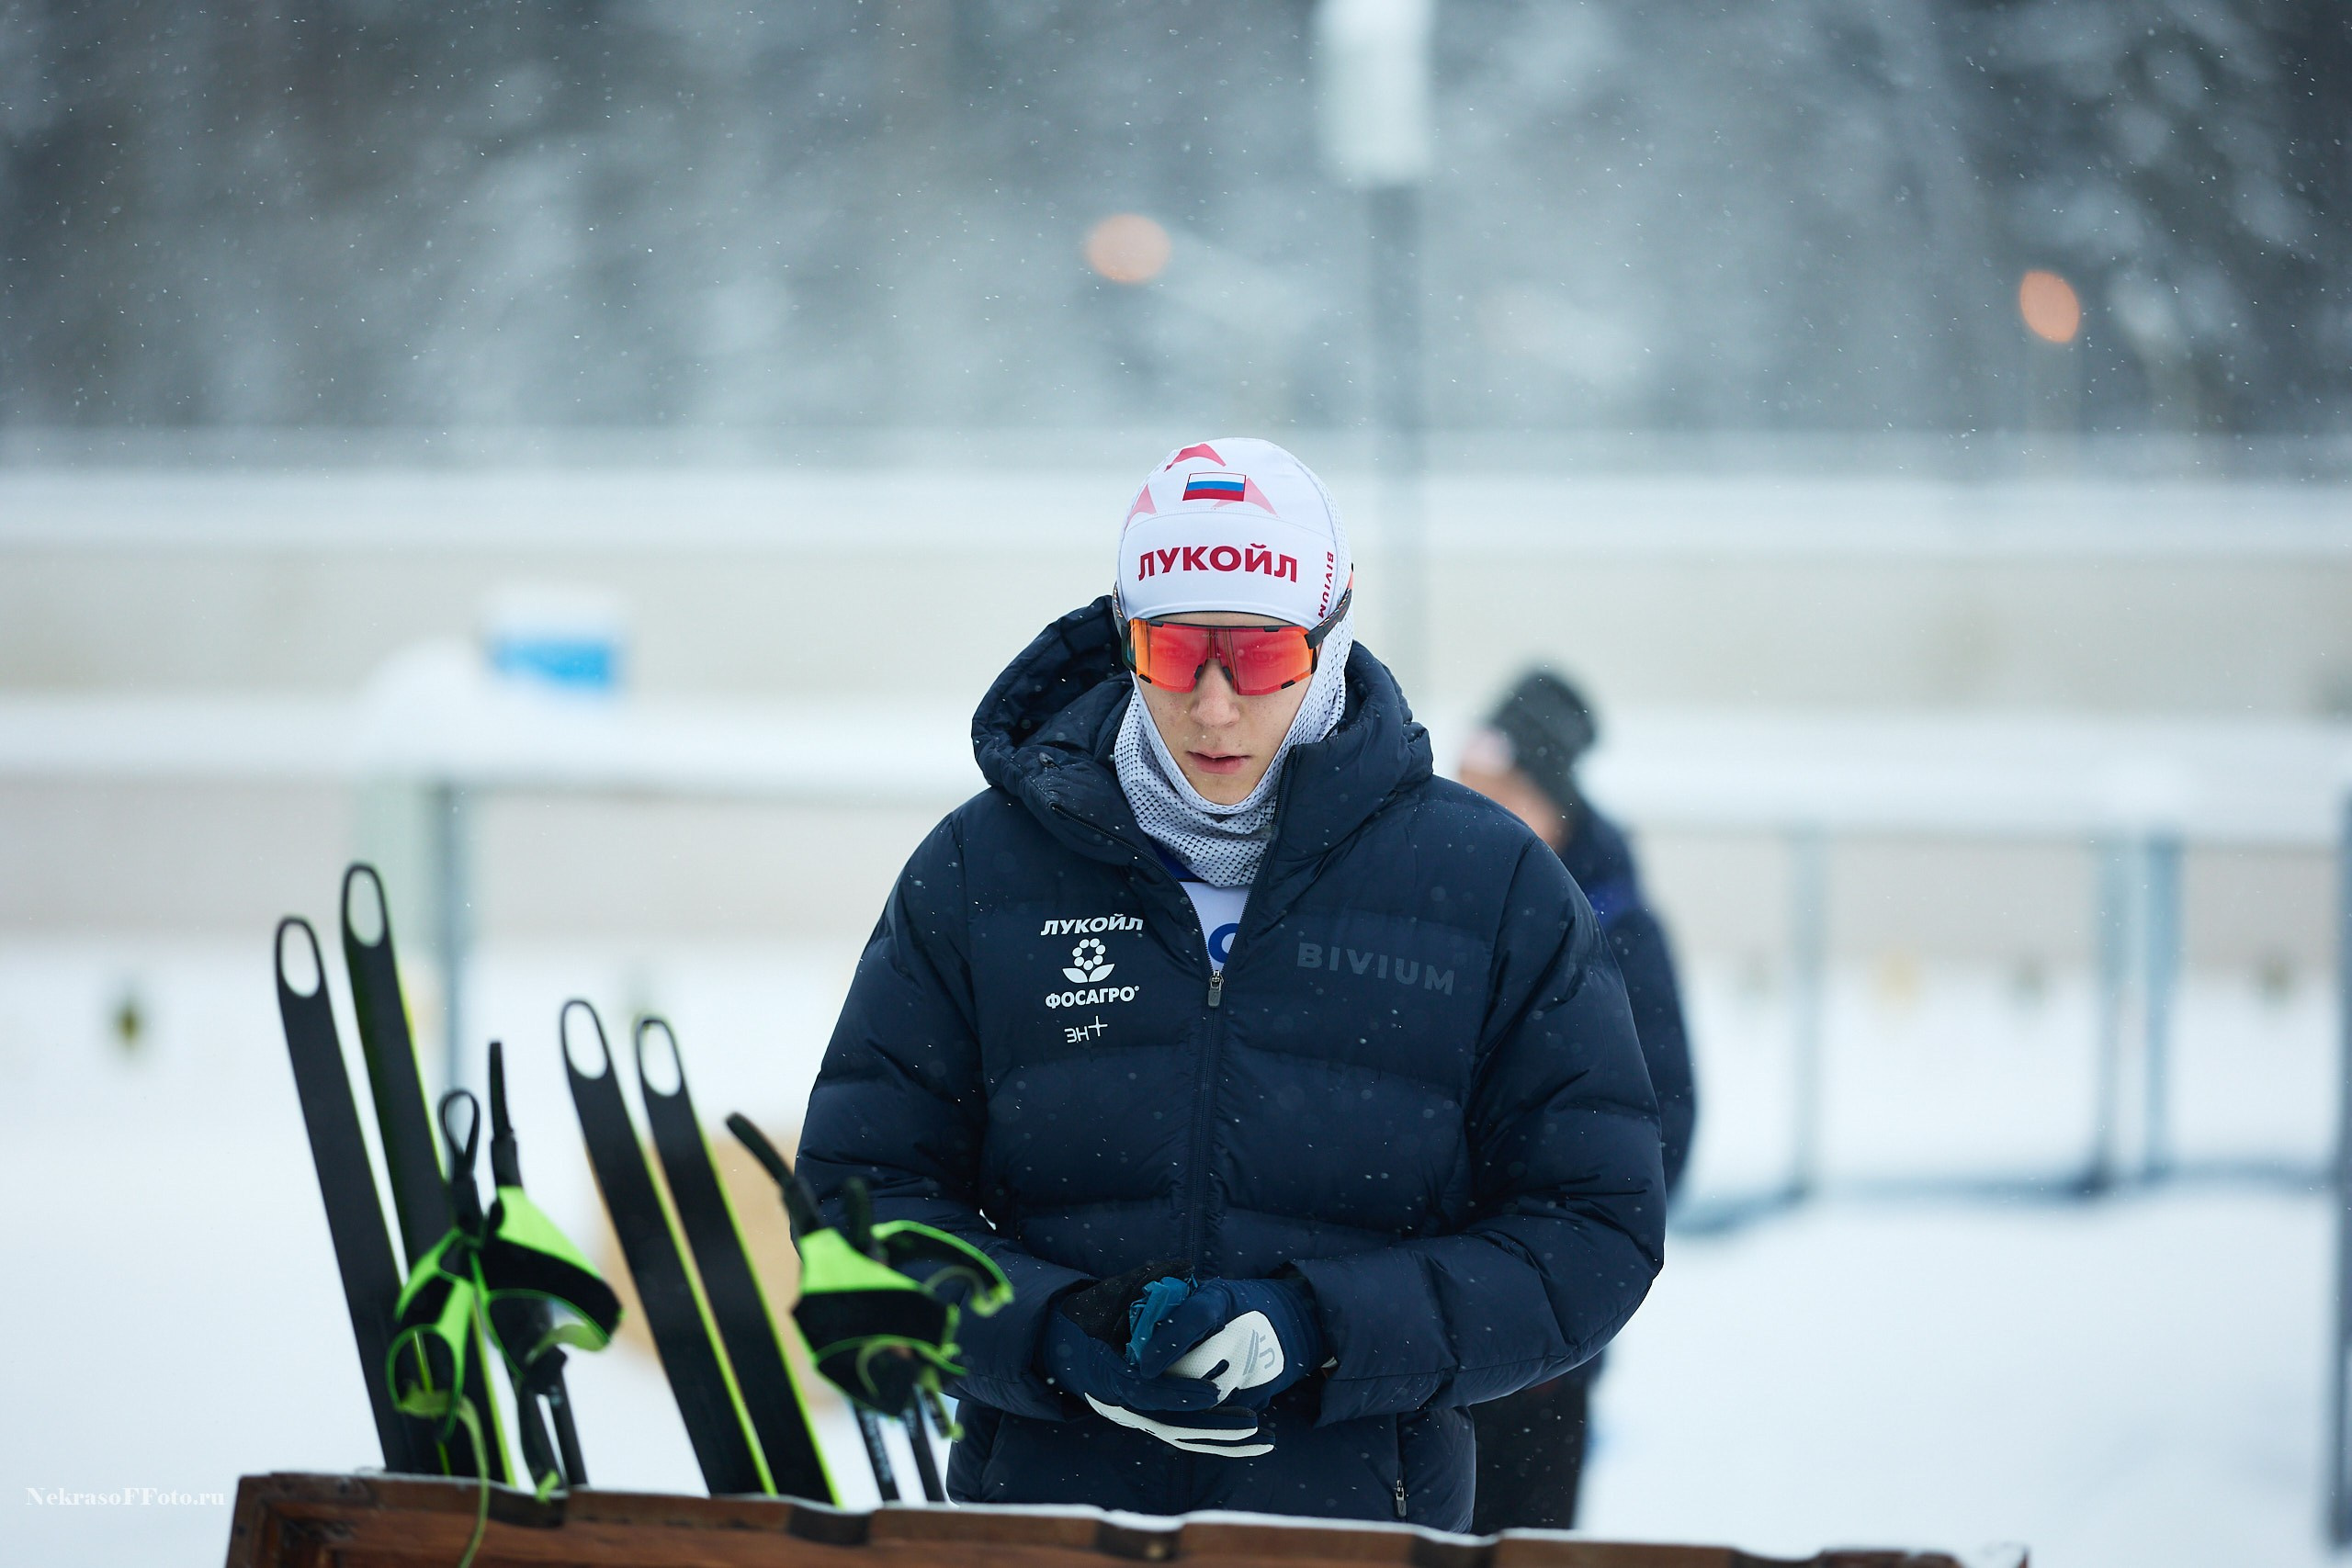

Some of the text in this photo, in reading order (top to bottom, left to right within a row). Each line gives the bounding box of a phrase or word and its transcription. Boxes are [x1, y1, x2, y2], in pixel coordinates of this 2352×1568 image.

[1138, 543, 1297, 582] ЛУКОЙЛ
[1317, 551, 1334, 619] BIVIUM
[1040, 913, 1144, 936] ЛУКОЙЛ
[1296, 942, 1455, 996] BIVIUM
